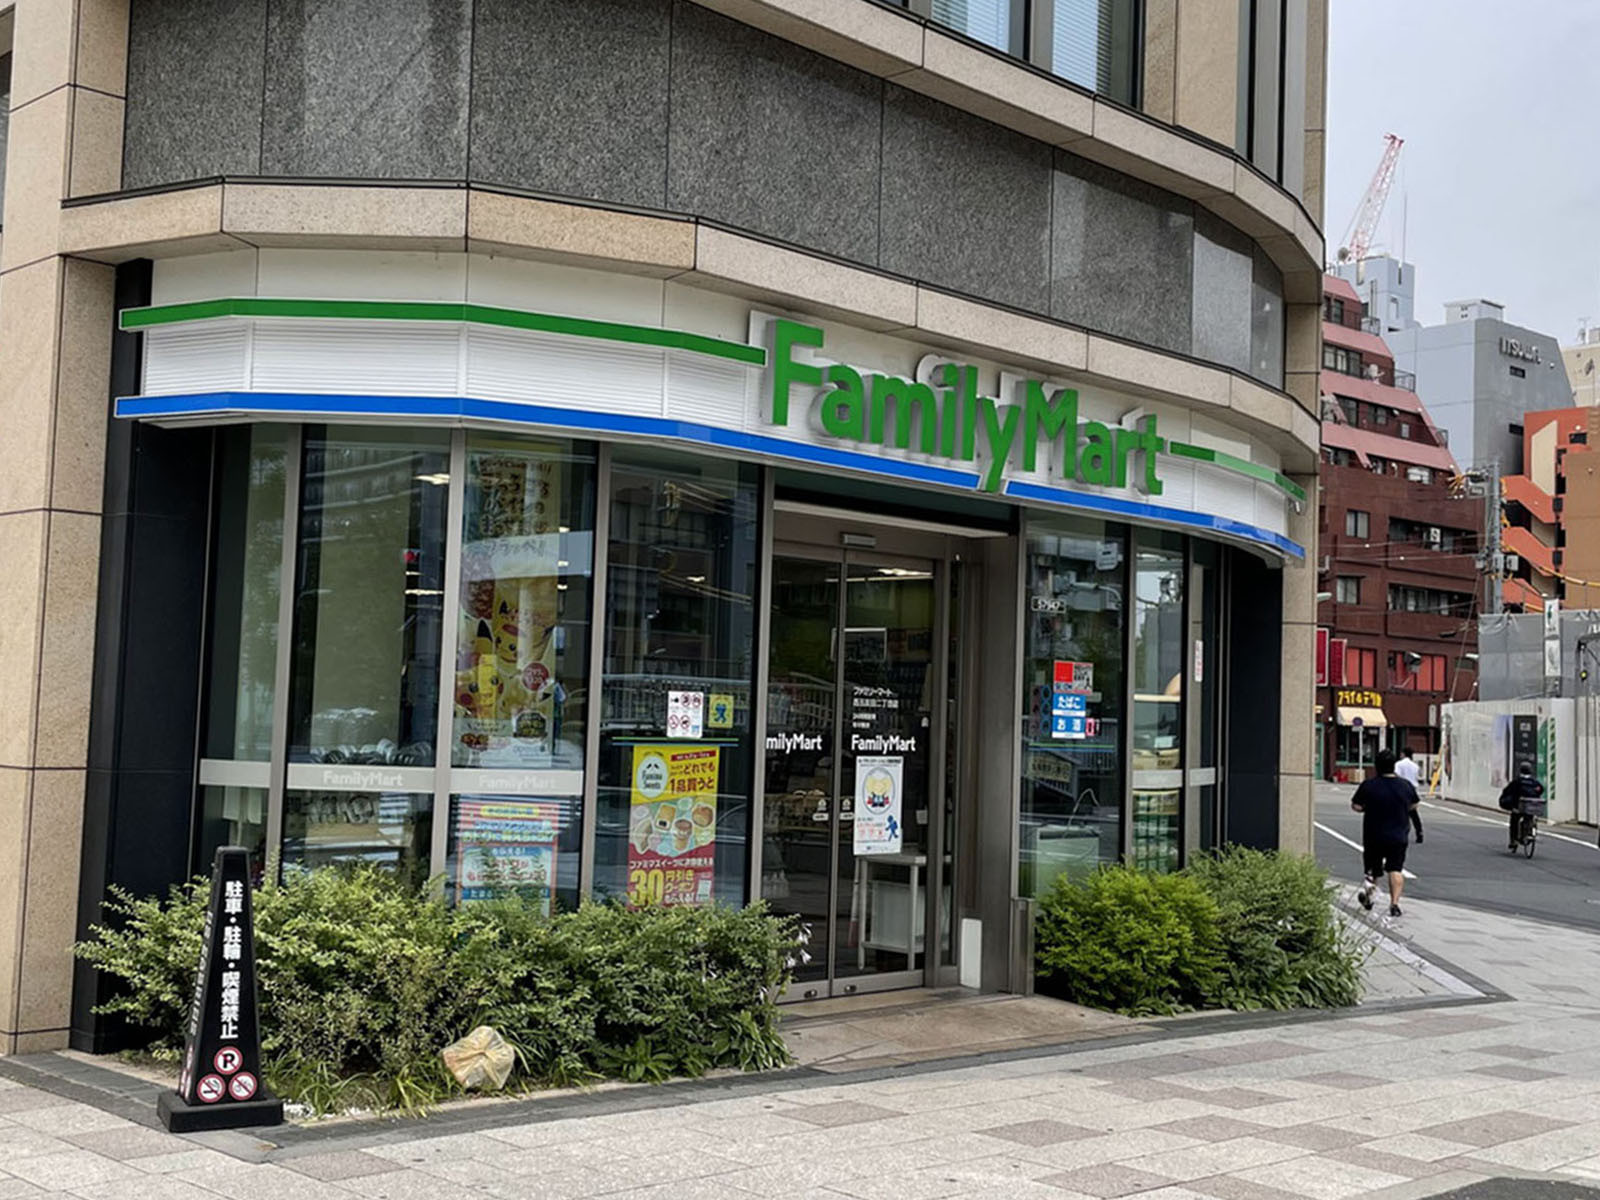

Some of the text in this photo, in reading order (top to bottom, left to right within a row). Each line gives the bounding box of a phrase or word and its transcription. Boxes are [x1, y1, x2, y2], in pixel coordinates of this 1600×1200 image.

[768, 319, 1165, 496] FamilyMart
[1058, 696, 1081, 709] たばこ
[766, 732, 823, 754] milyMart
[851, 734, 916, 755] FamilyMart
[684, 762, 715, 775] どれでも
[323, 770, 404, 789] FamilyMart
[479, 774, 557, 792] FamilyMart
